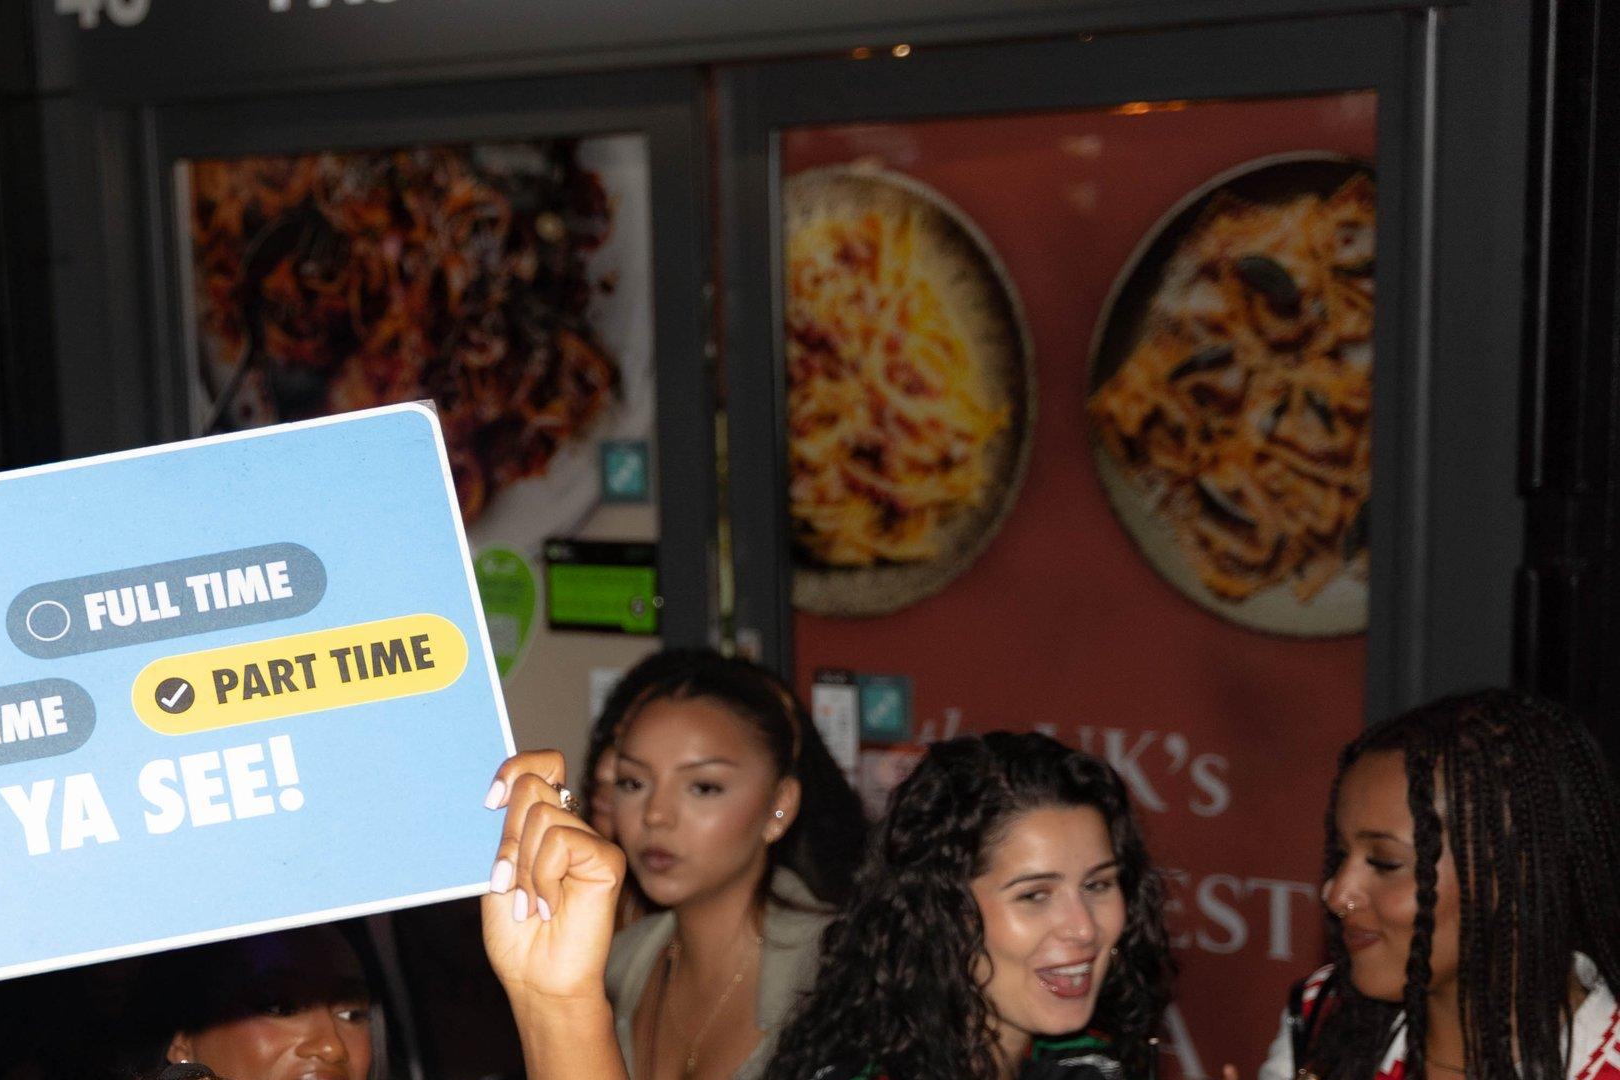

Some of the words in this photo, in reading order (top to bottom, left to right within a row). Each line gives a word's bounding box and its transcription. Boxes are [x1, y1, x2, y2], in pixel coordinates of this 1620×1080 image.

[84, 581, 180, 631] FULL
[186, 560, 293, 613] TIME
[212, 653, 316, 704] PART
[330, 633, 435, 683] TIME
[138, 734, 304, 835] SEE!
